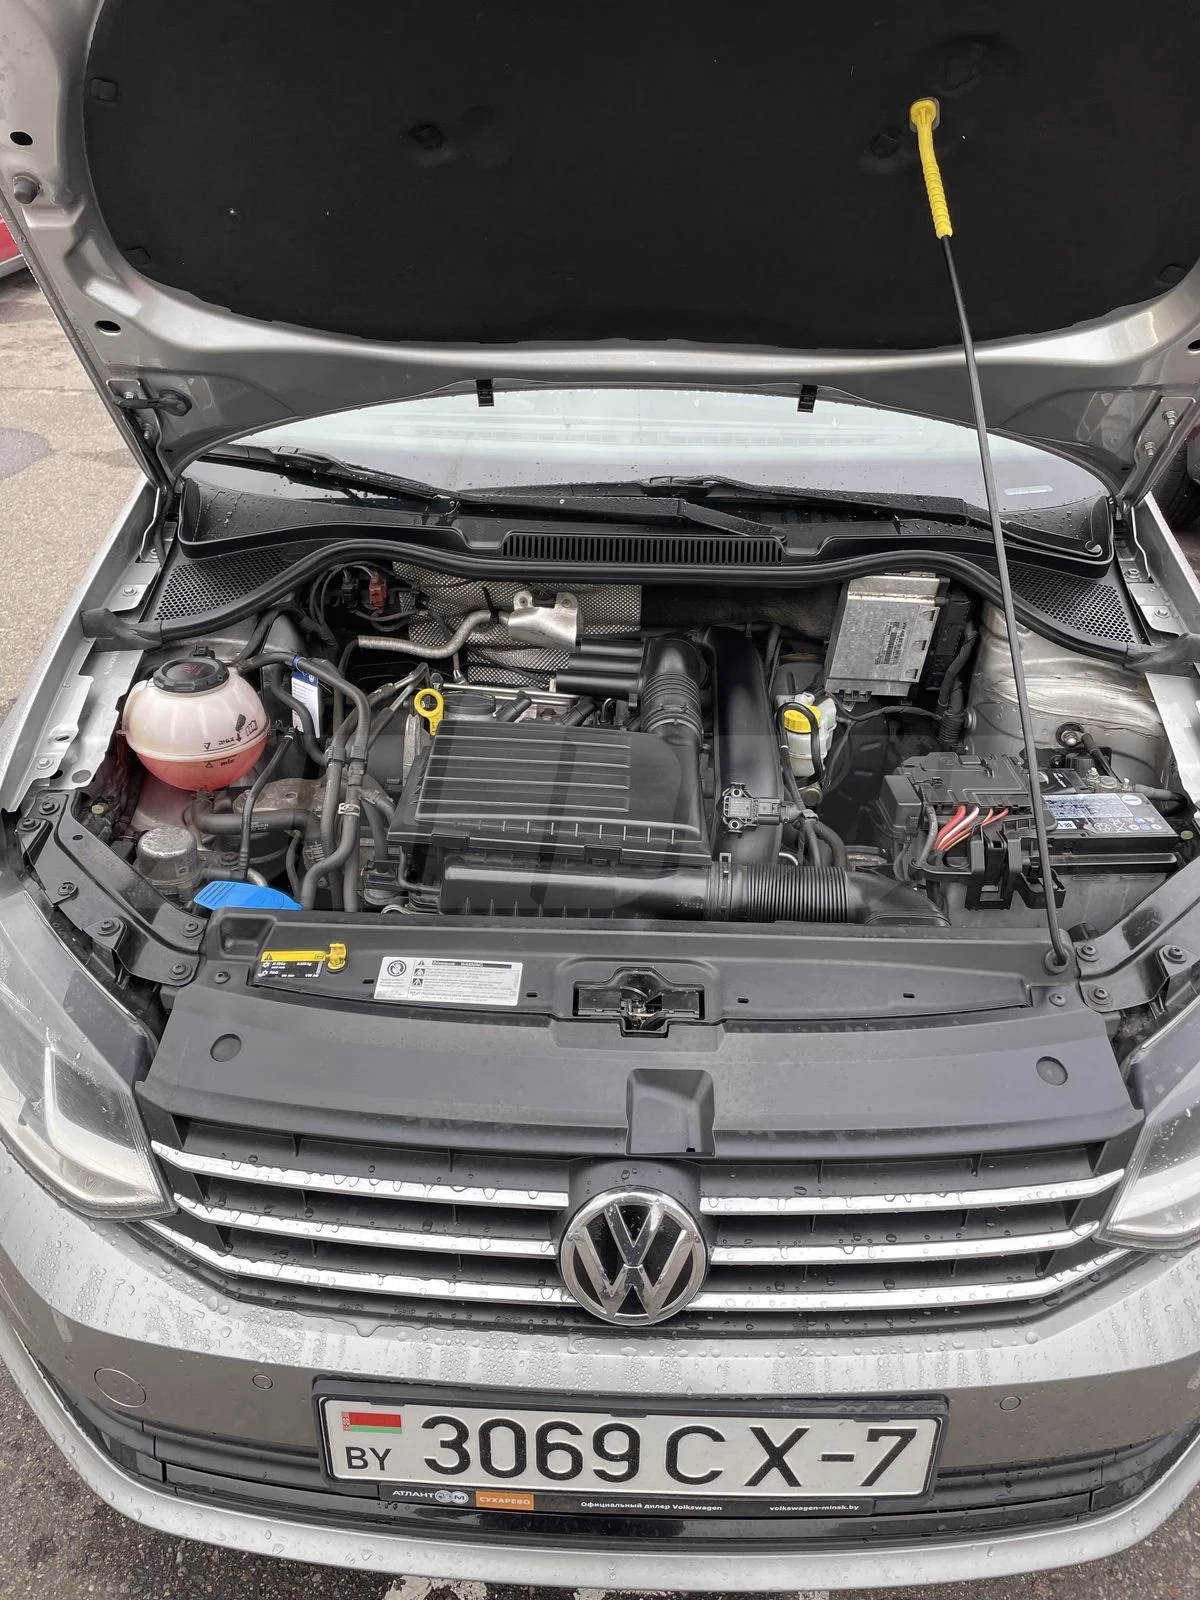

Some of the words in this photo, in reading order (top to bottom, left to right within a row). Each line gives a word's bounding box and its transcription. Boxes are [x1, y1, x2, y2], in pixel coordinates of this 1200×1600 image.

[561, 1189, 707, 1326] VW
[421, 1414, 641, 1483] 3069
[344, 1446, 392, 1471] BY
[392, 1490, 435, 1499] АТЛАНТ
[479, 1496, 531, 1506] СУХАРЕВО
[580, 1501, 642, 1509] Официальный
